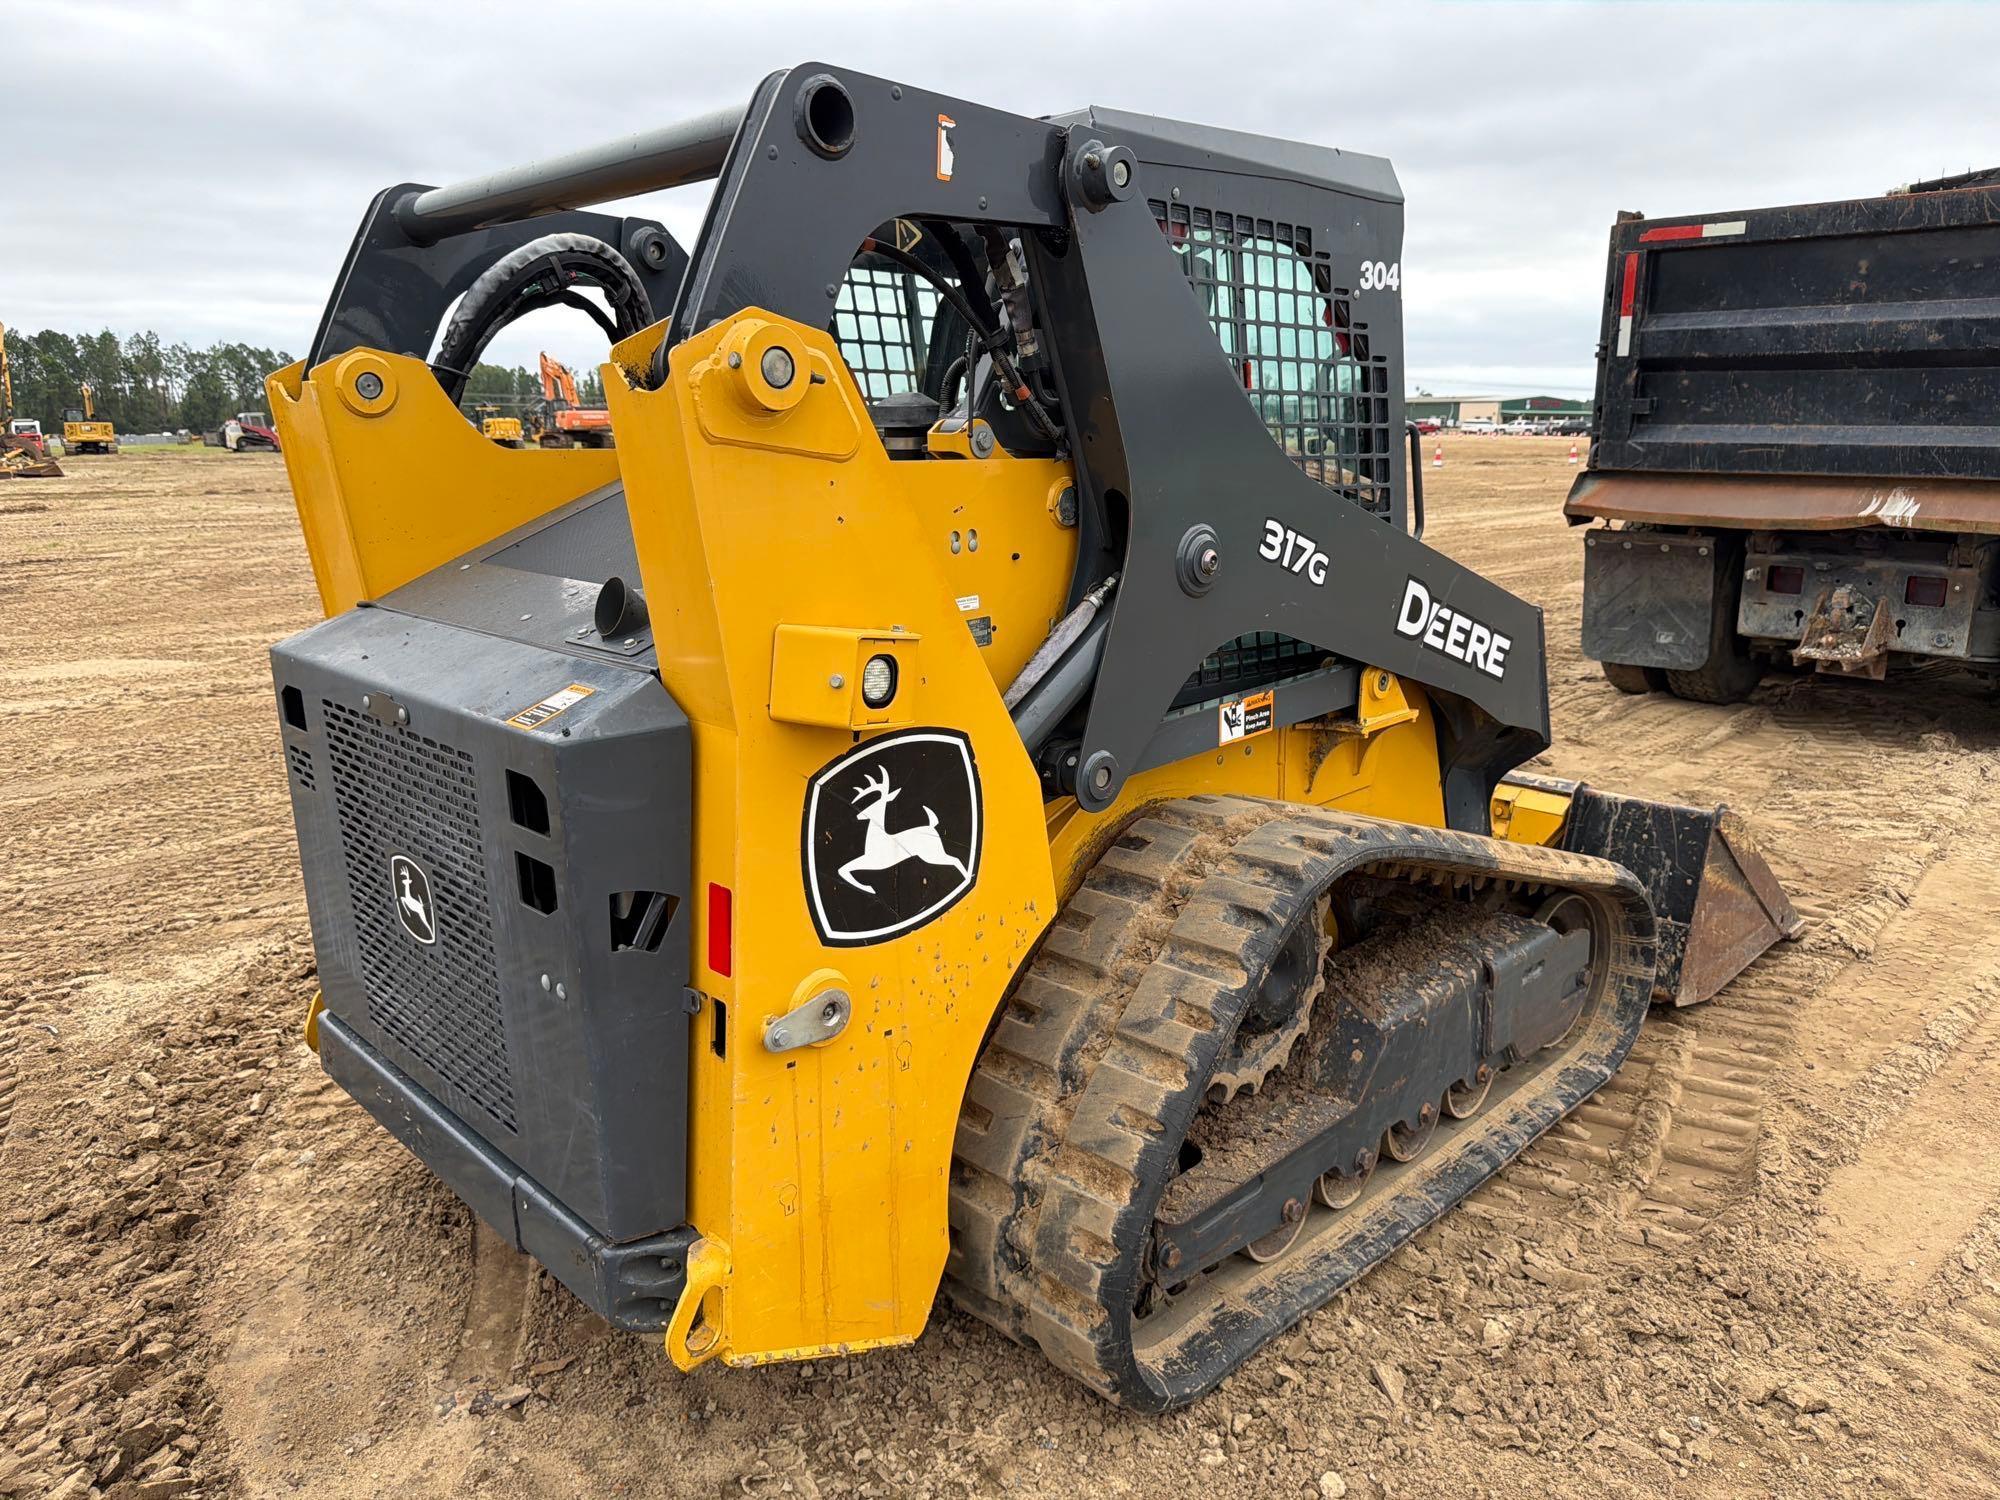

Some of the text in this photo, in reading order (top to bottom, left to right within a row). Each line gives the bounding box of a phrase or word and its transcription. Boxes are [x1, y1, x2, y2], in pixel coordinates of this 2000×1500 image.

[1360, 260, 1400, 291] 304
[1259, 519, 1329, 585] 317G
[1397, 579, 1511, 678] DEERE
